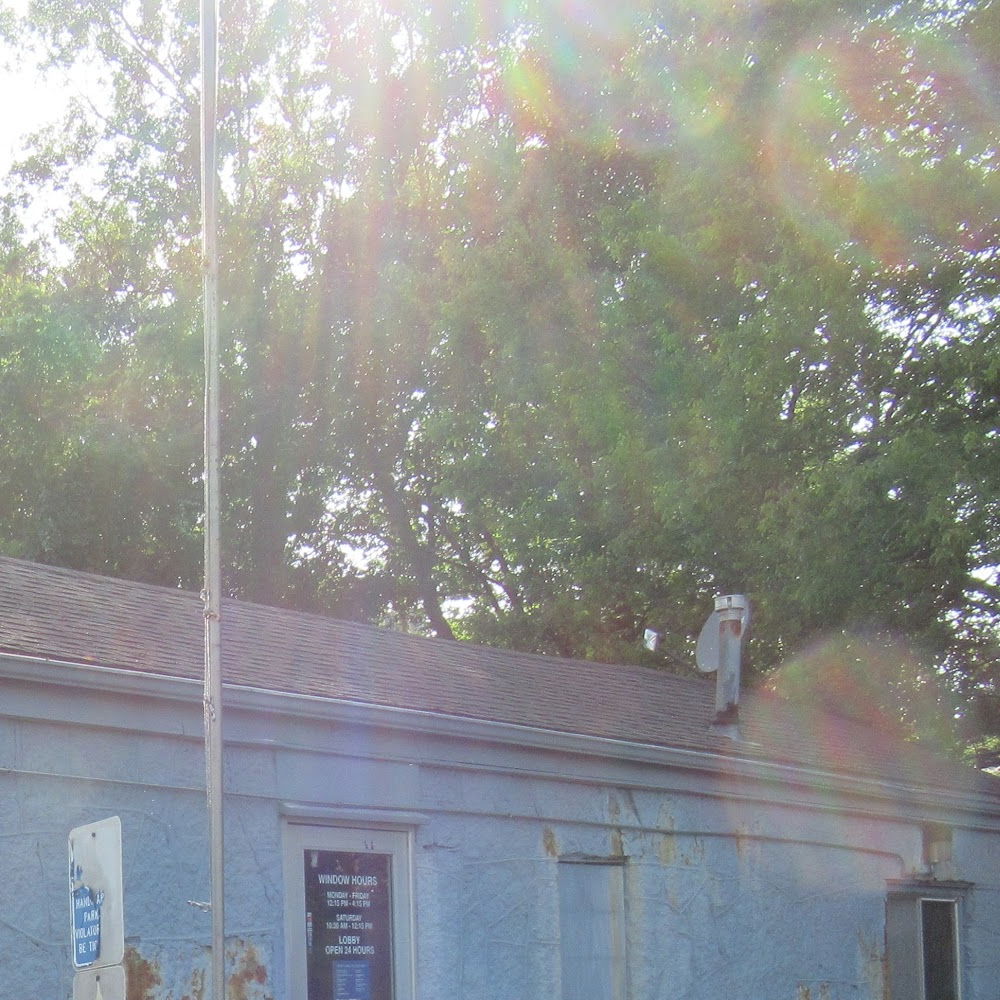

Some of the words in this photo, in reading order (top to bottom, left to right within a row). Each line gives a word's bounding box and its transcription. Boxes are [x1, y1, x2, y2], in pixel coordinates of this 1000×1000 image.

[318, 874, 350, 885] WINDOW
[351, 875, 378, 886] HOURS
[326, 891, 348, 899] MONDAY
[352, 892, 370, 900] FRIDAY
[340, 899, 349, 907] PM
[362, 900, 371, 908] PM
[335, 913, 363, 922] SATURDAY
[339, 935, 360, 945] LOBBY
[325, 945, 344, 955] OPEN
[344, 945, 352, 955] 24
[352, 945, 375, 955] HOURS
